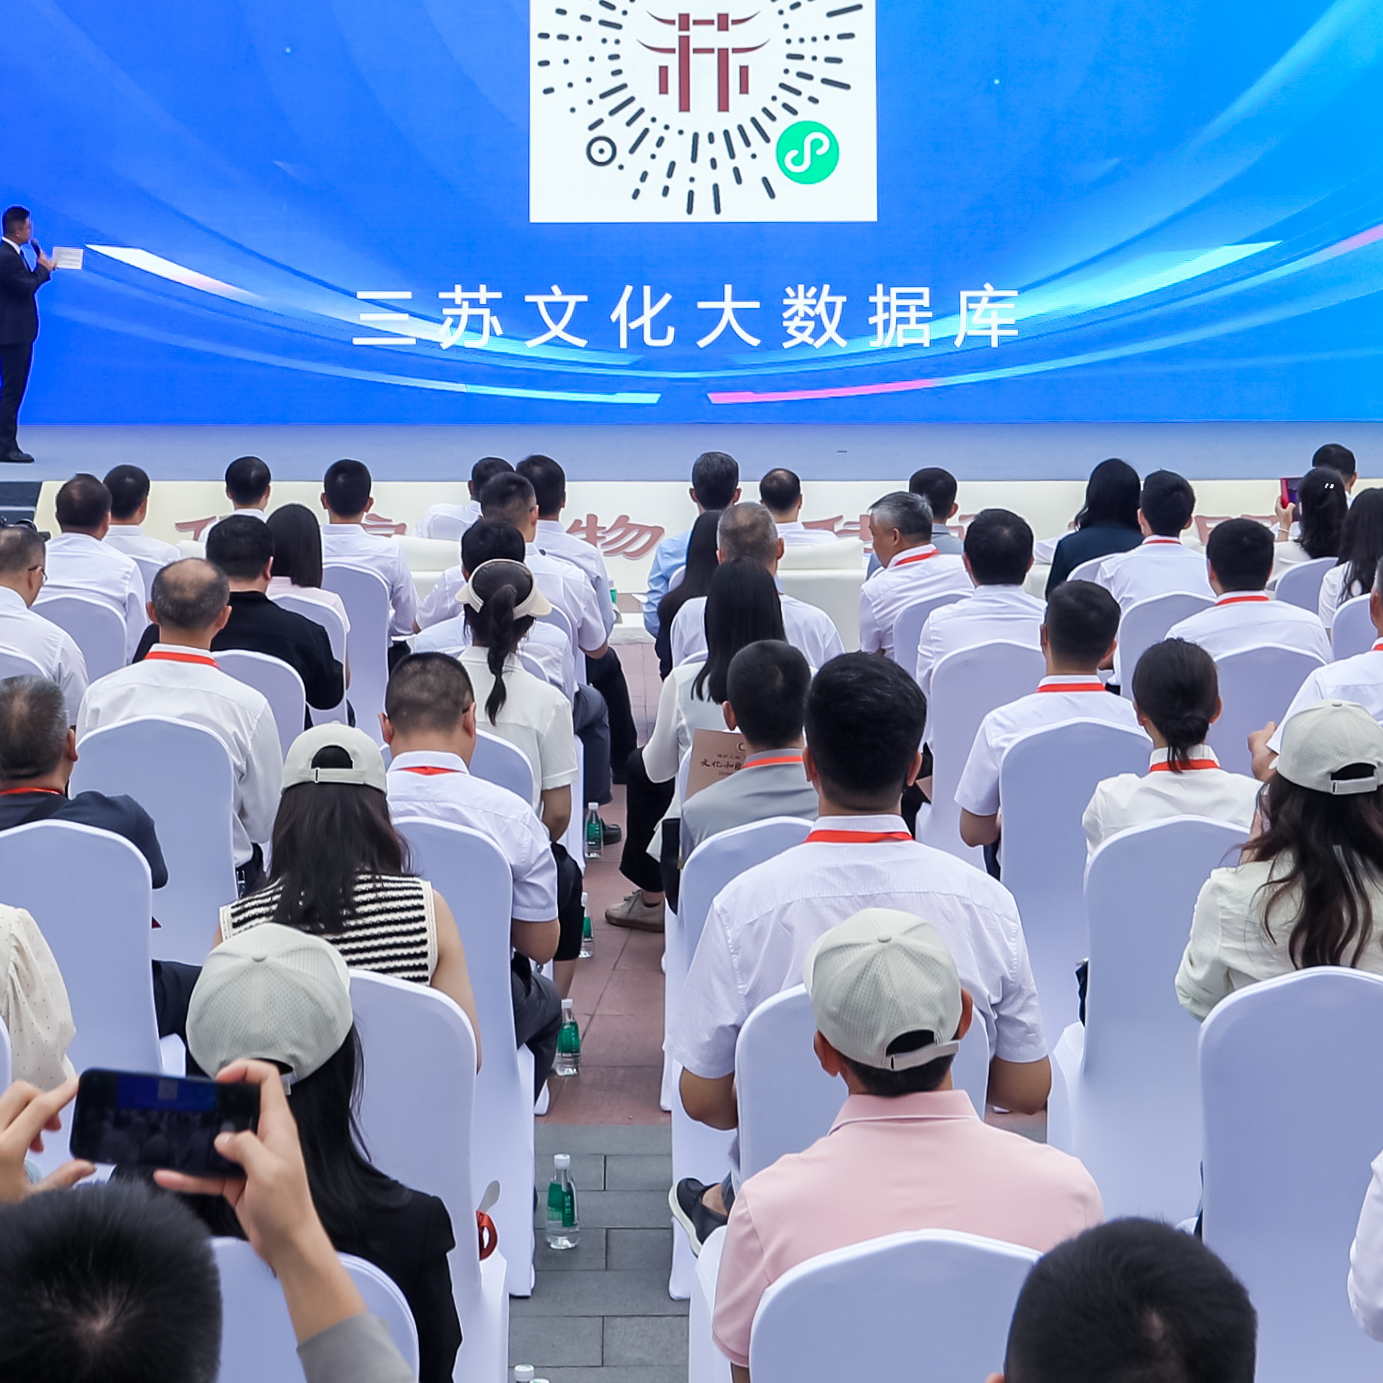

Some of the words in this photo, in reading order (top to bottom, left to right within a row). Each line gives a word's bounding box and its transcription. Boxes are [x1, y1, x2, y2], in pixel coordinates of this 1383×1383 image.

[353, 284, 1020, 349] 三苏文化大数据库
